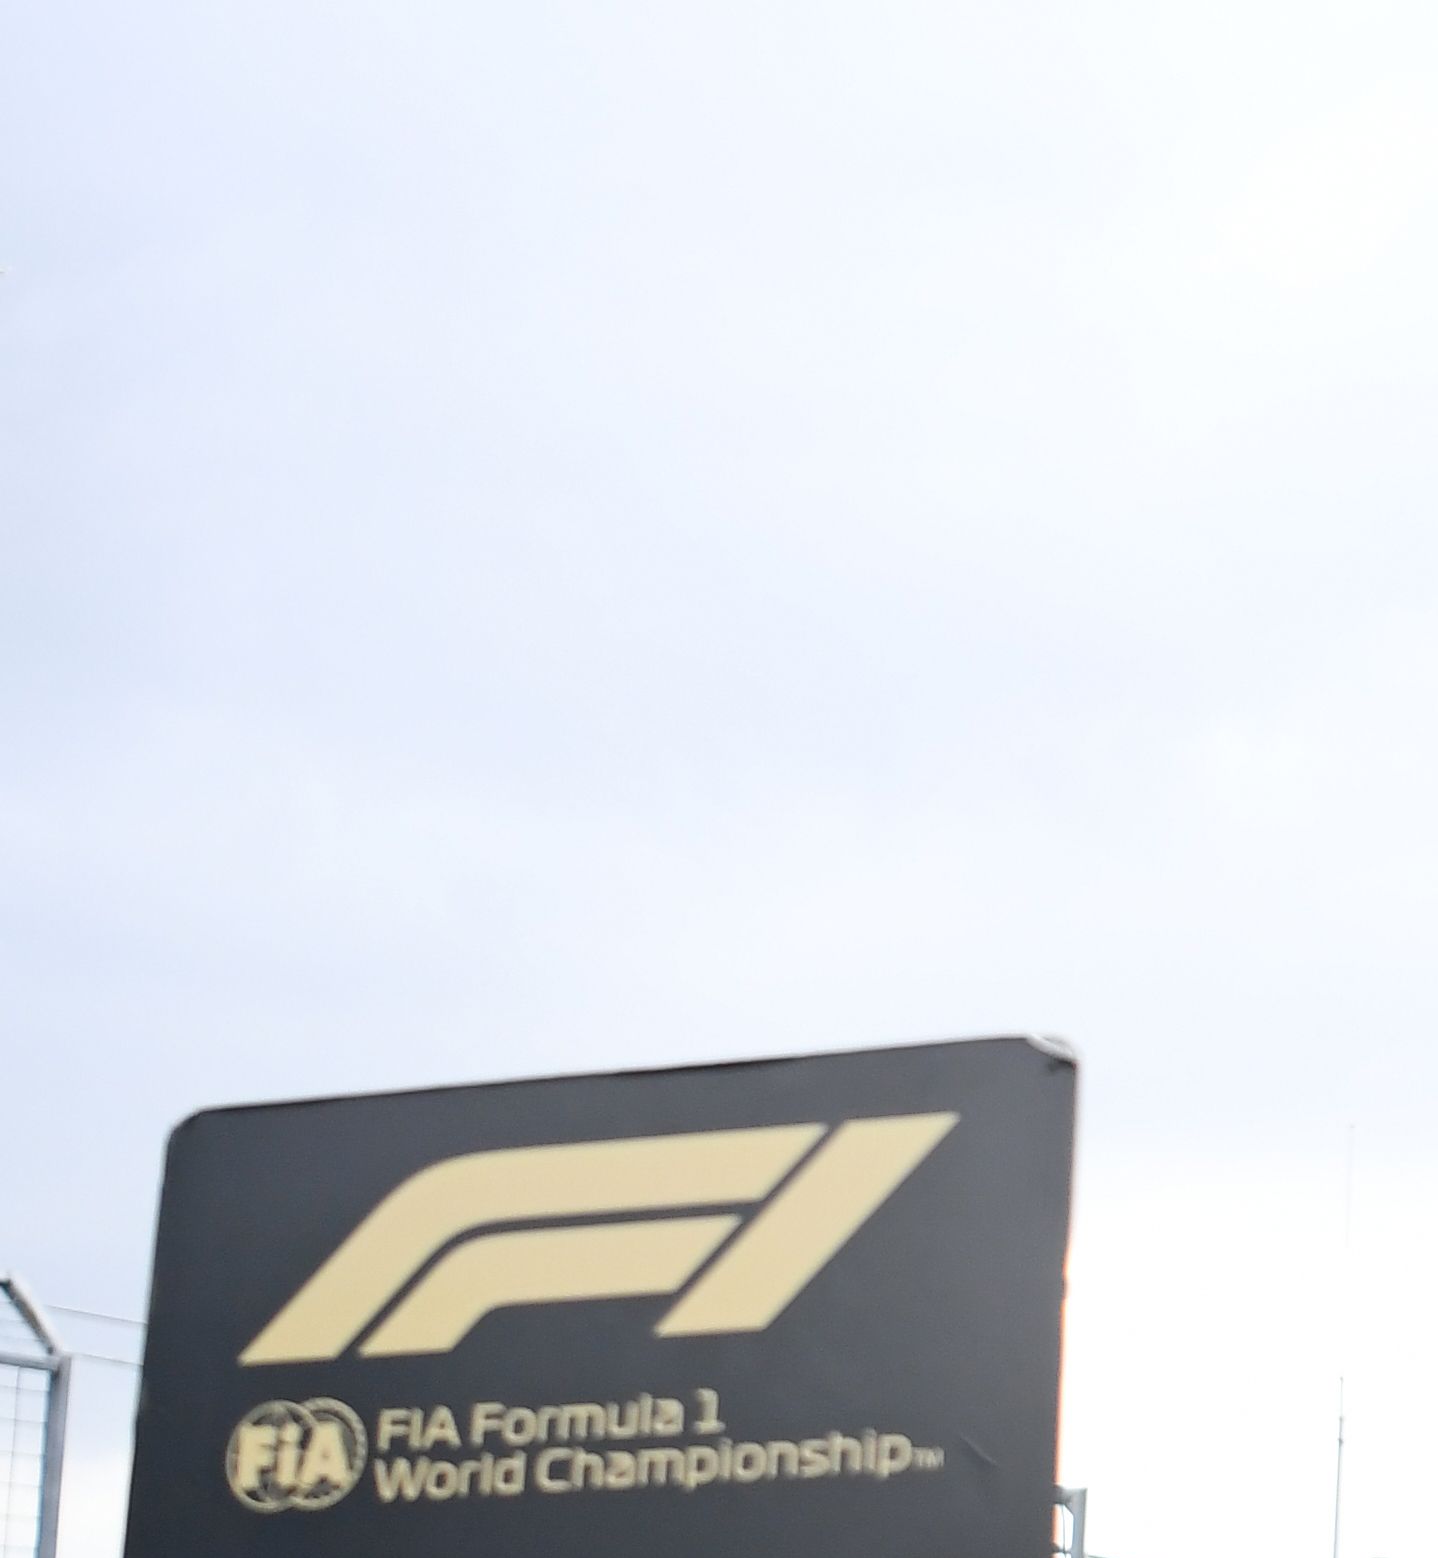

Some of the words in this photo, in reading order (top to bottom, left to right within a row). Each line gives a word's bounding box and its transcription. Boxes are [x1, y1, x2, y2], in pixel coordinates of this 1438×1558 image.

[238, 1112, 960, 1367] F1
[376, 1407, 461, 1453] FIA
[469, 1393, 686, 1447] Formula
[694, 1387, 726, 1436] 1
[374, 1450, 526, 1503] World
